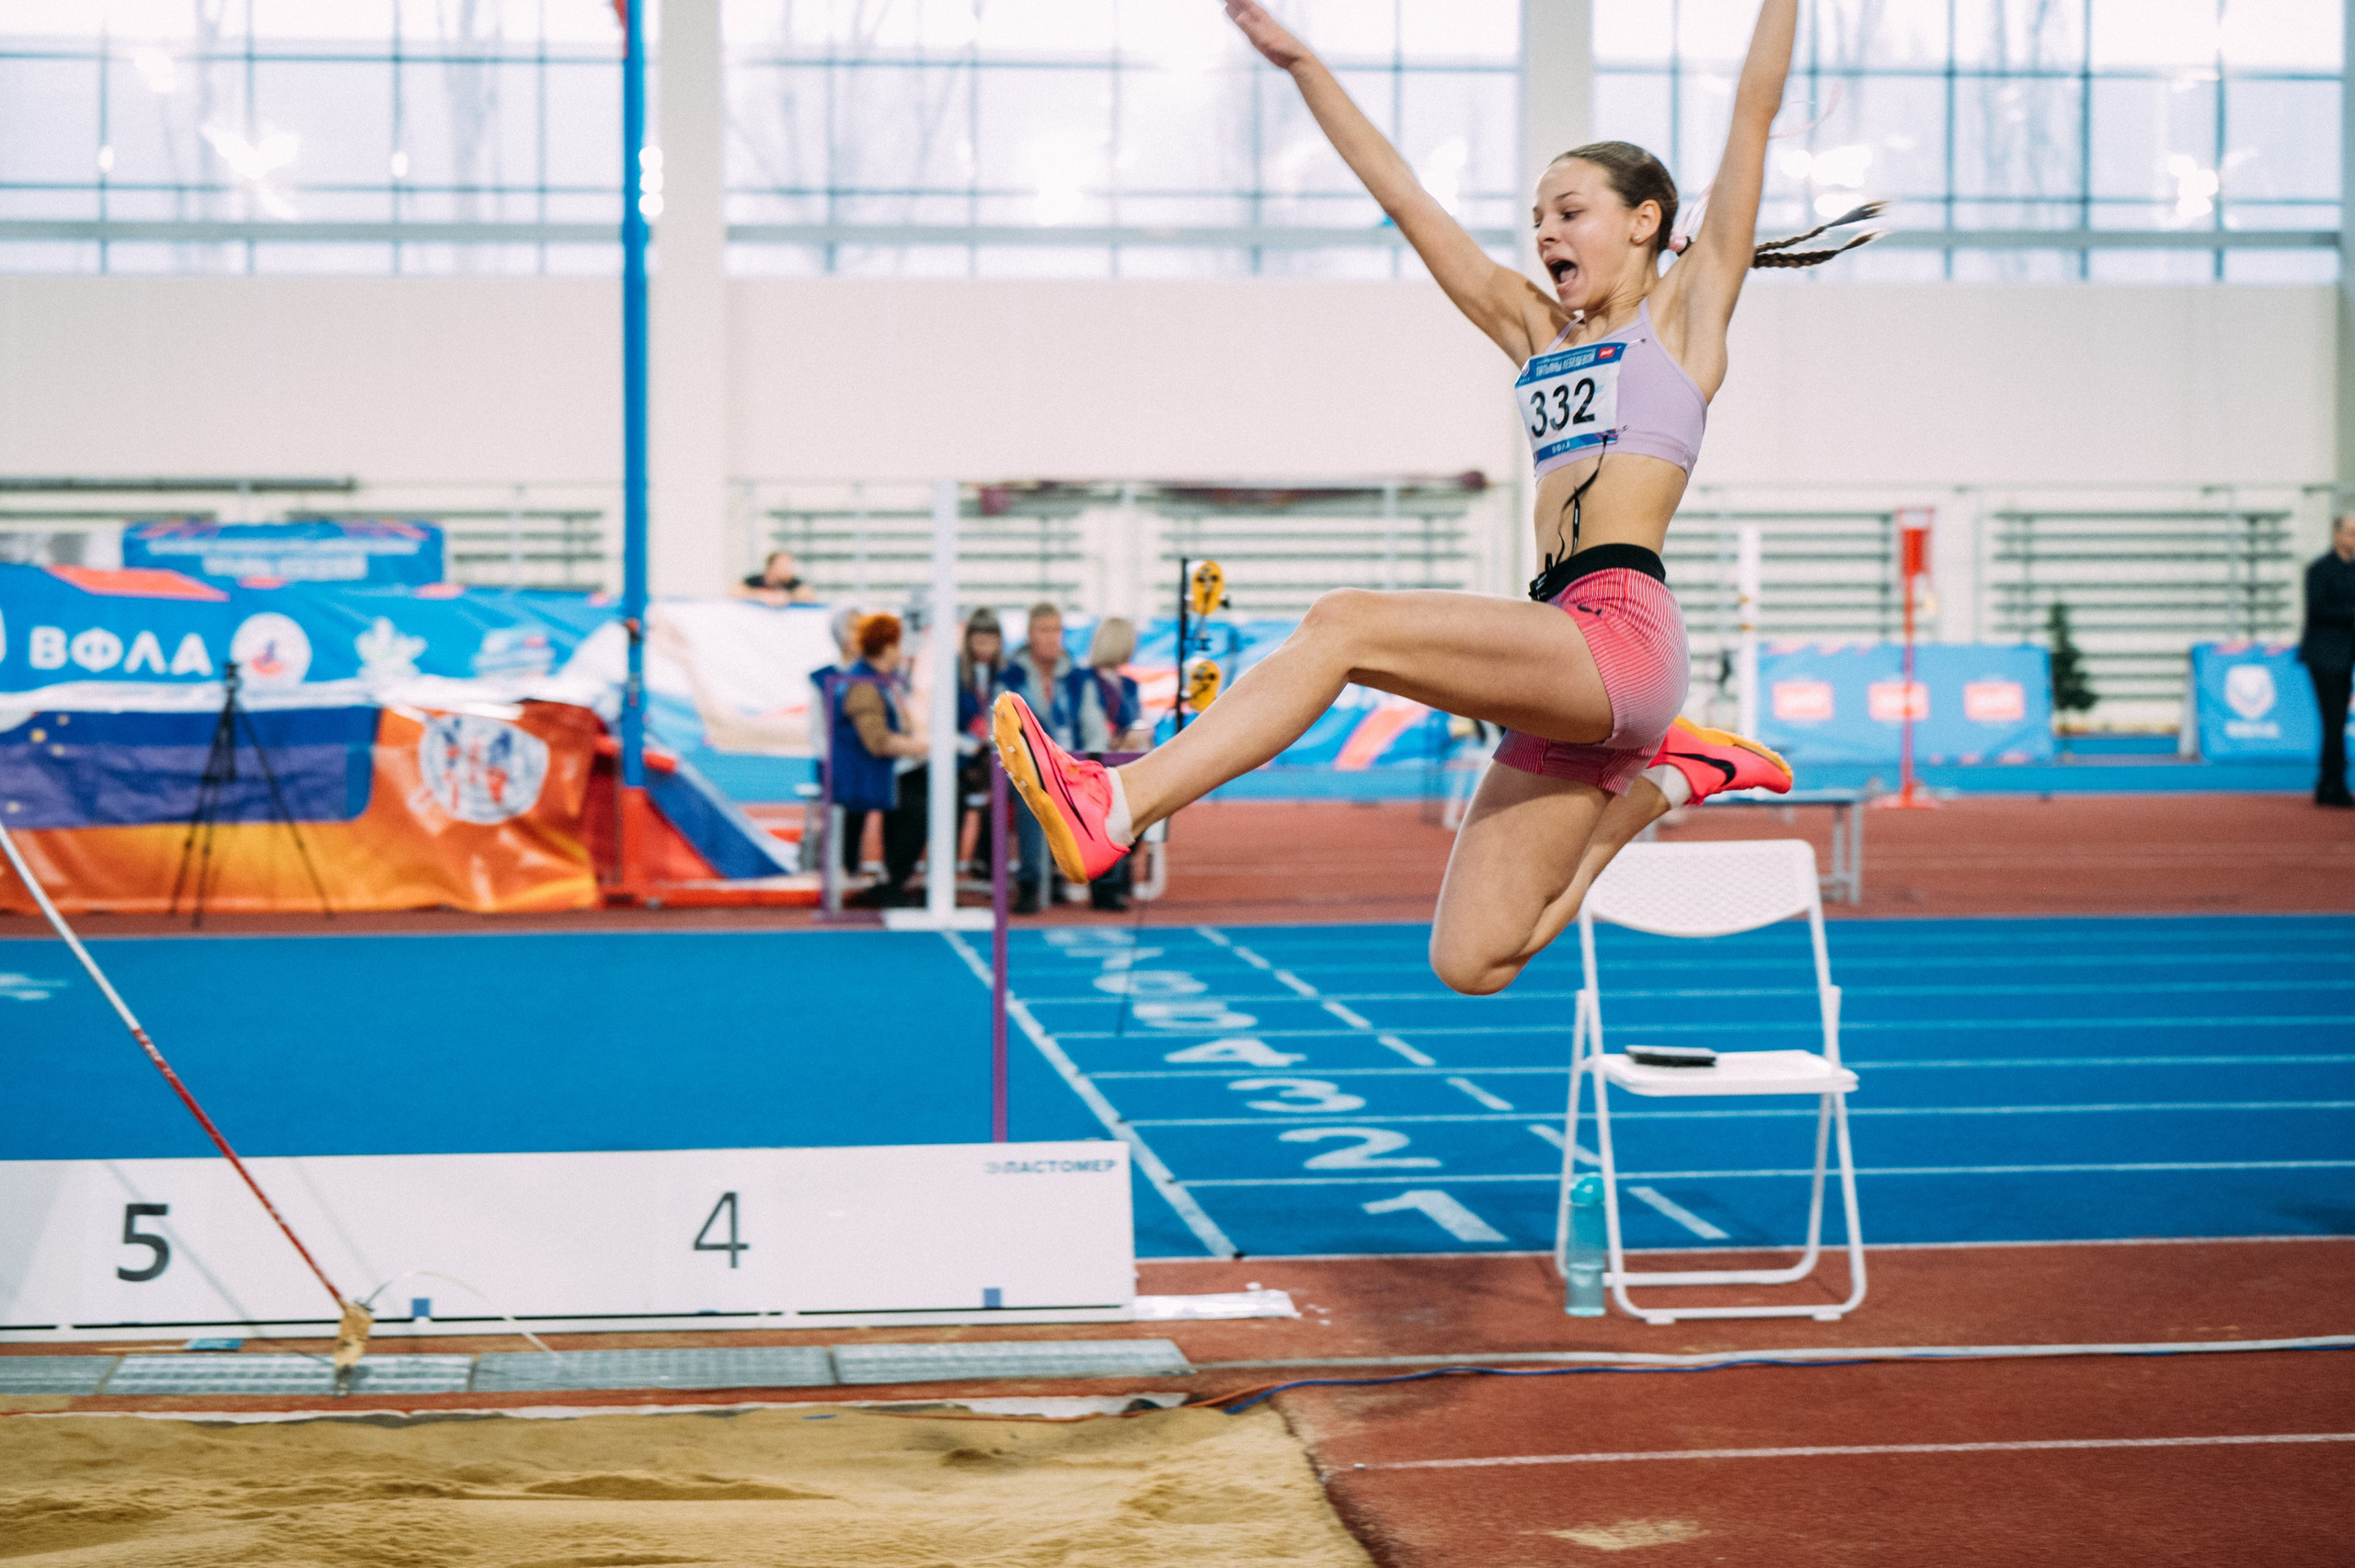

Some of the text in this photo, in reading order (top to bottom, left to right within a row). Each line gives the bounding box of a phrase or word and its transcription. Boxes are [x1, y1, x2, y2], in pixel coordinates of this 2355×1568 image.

[1530, 376, 1595, 439] 332
[29, 624, 213, 677] ВФЛА
[1163, 1038, 1307, 1068] 4
[1226, 1078, 1367, 1113] 3
[1277, 1127, 1442, 1170] 2
[694, 1191, 750, 1269] 4
[1361, 1189, 1509, 1242] 1
[116, 1202, 171, 1283] 5
